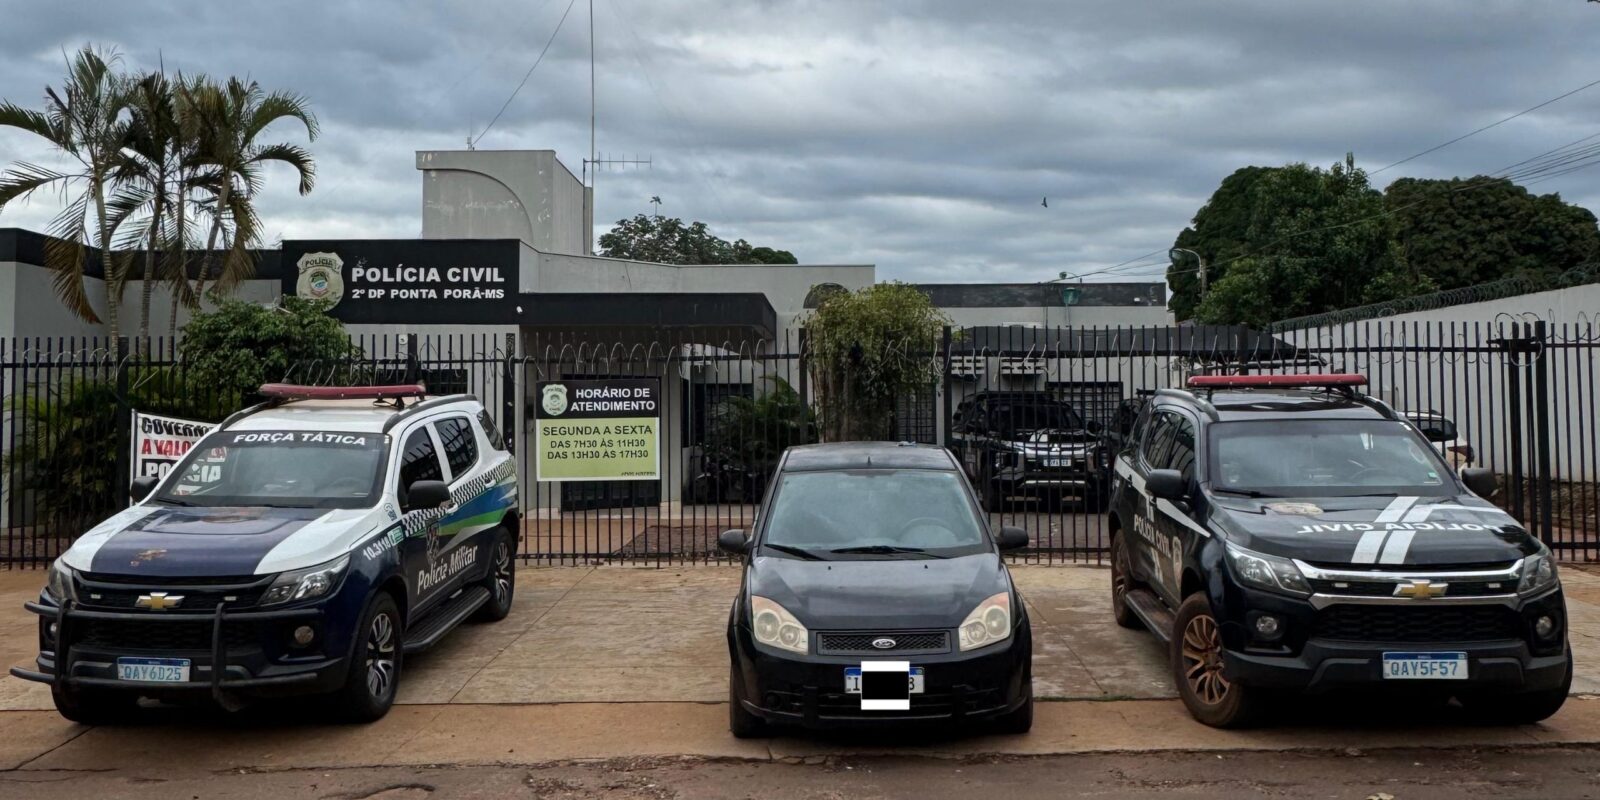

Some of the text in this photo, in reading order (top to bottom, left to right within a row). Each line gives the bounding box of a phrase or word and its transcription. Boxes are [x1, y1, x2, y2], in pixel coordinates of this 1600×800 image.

[352, 264, 505, 283] POLÍCIA CIVIL
[368, 288, 386, 299] DP
[391, 288, 438, 299] PONTA
[444, 287, 505, 299] PORÃ-MS
[576, 386, 631, 399] HORÁRIO
[634, 388, 650, 398] DE
[571, 400, 656, 412] ATENDIMENTO
[543, 425, 652, 436] SEGUNDA A SEXTA
[233, 431, 366, 446] FORÇA TÁTICA
[550, 440, 571, 449] DAS
[574, 440, 597, 448] 7H30
[618, 439, 646, 447] 11H30
[141, 438, 152, 455] A
[547, 451, 568, 460] DAS
[572, 451, 600, 459] 13H30
[619, 450, 649, 458] 17H30
[417, 545, 478, 595] Polícia Militar
[124, 665, 182, 681] QAY6D25
[1390, 661, 1458, 676] QAY5F57
